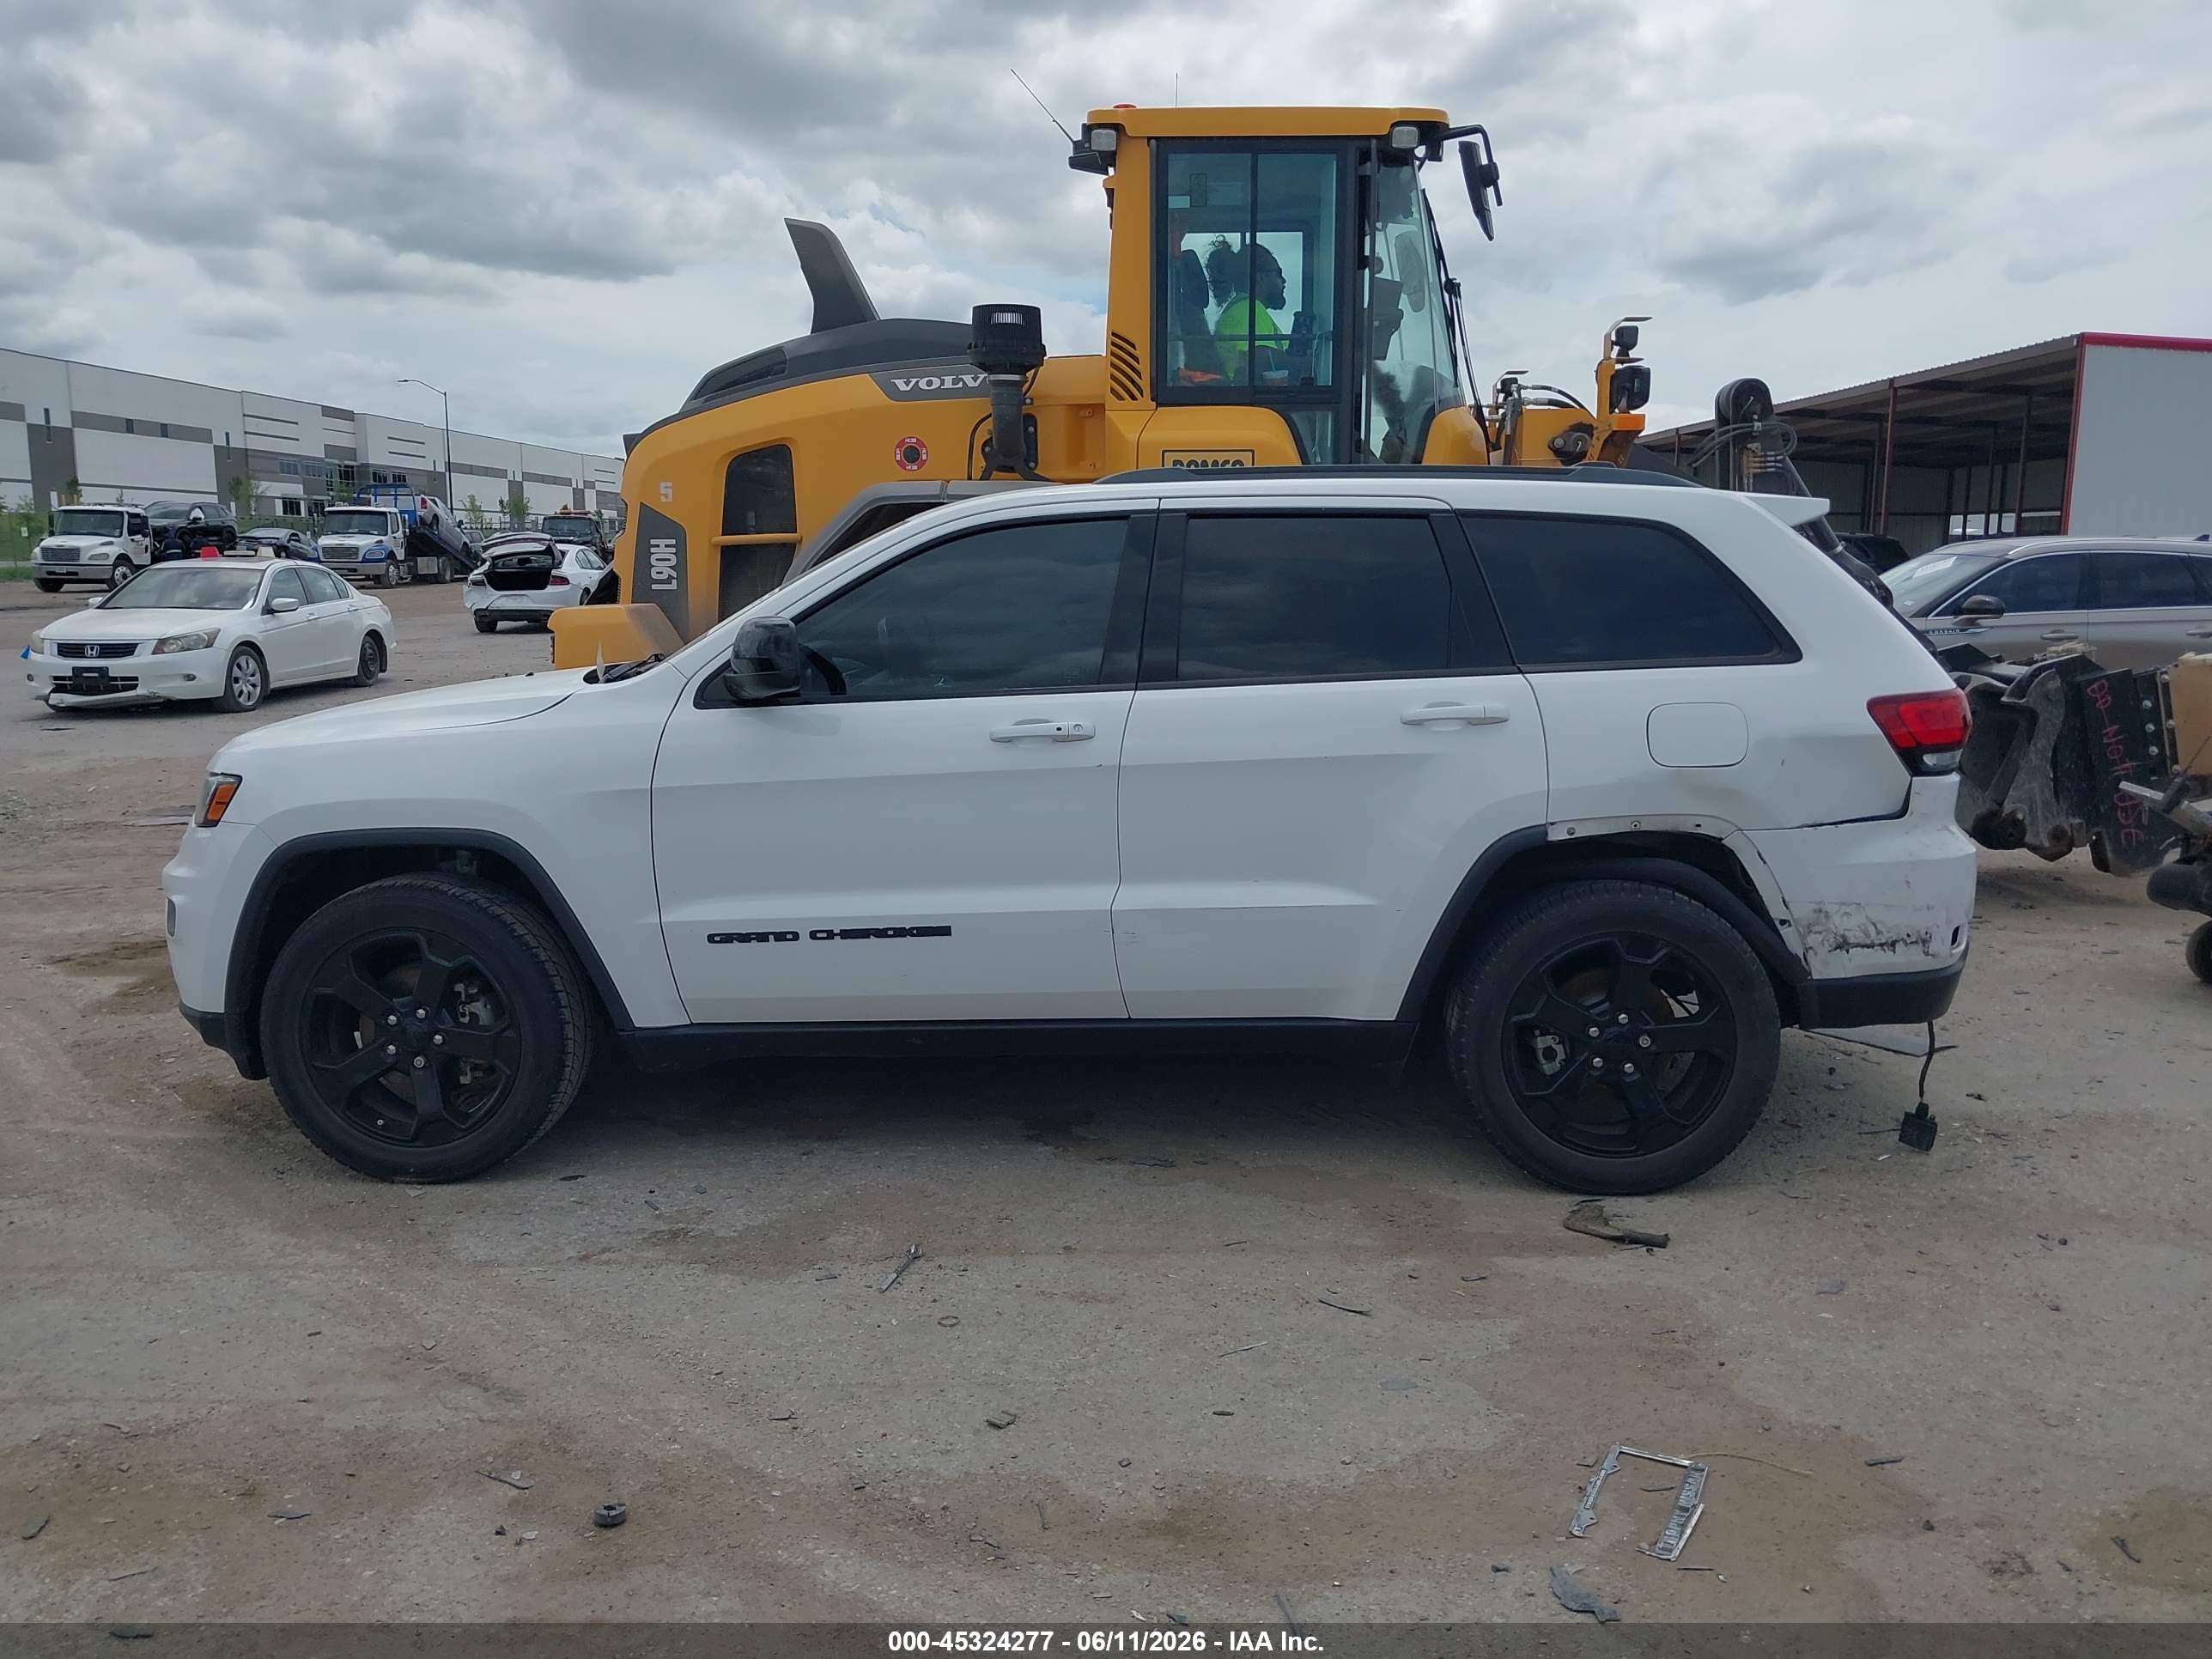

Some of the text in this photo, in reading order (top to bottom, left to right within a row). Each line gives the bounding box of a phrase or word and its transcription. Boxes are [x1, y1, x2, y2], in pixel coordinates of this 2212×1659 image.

[890, 374, 989, 392] VOLV
[649, 538, 678, 590] L90H
[707, 925, 952, 945] GRAND CHEROKEE
